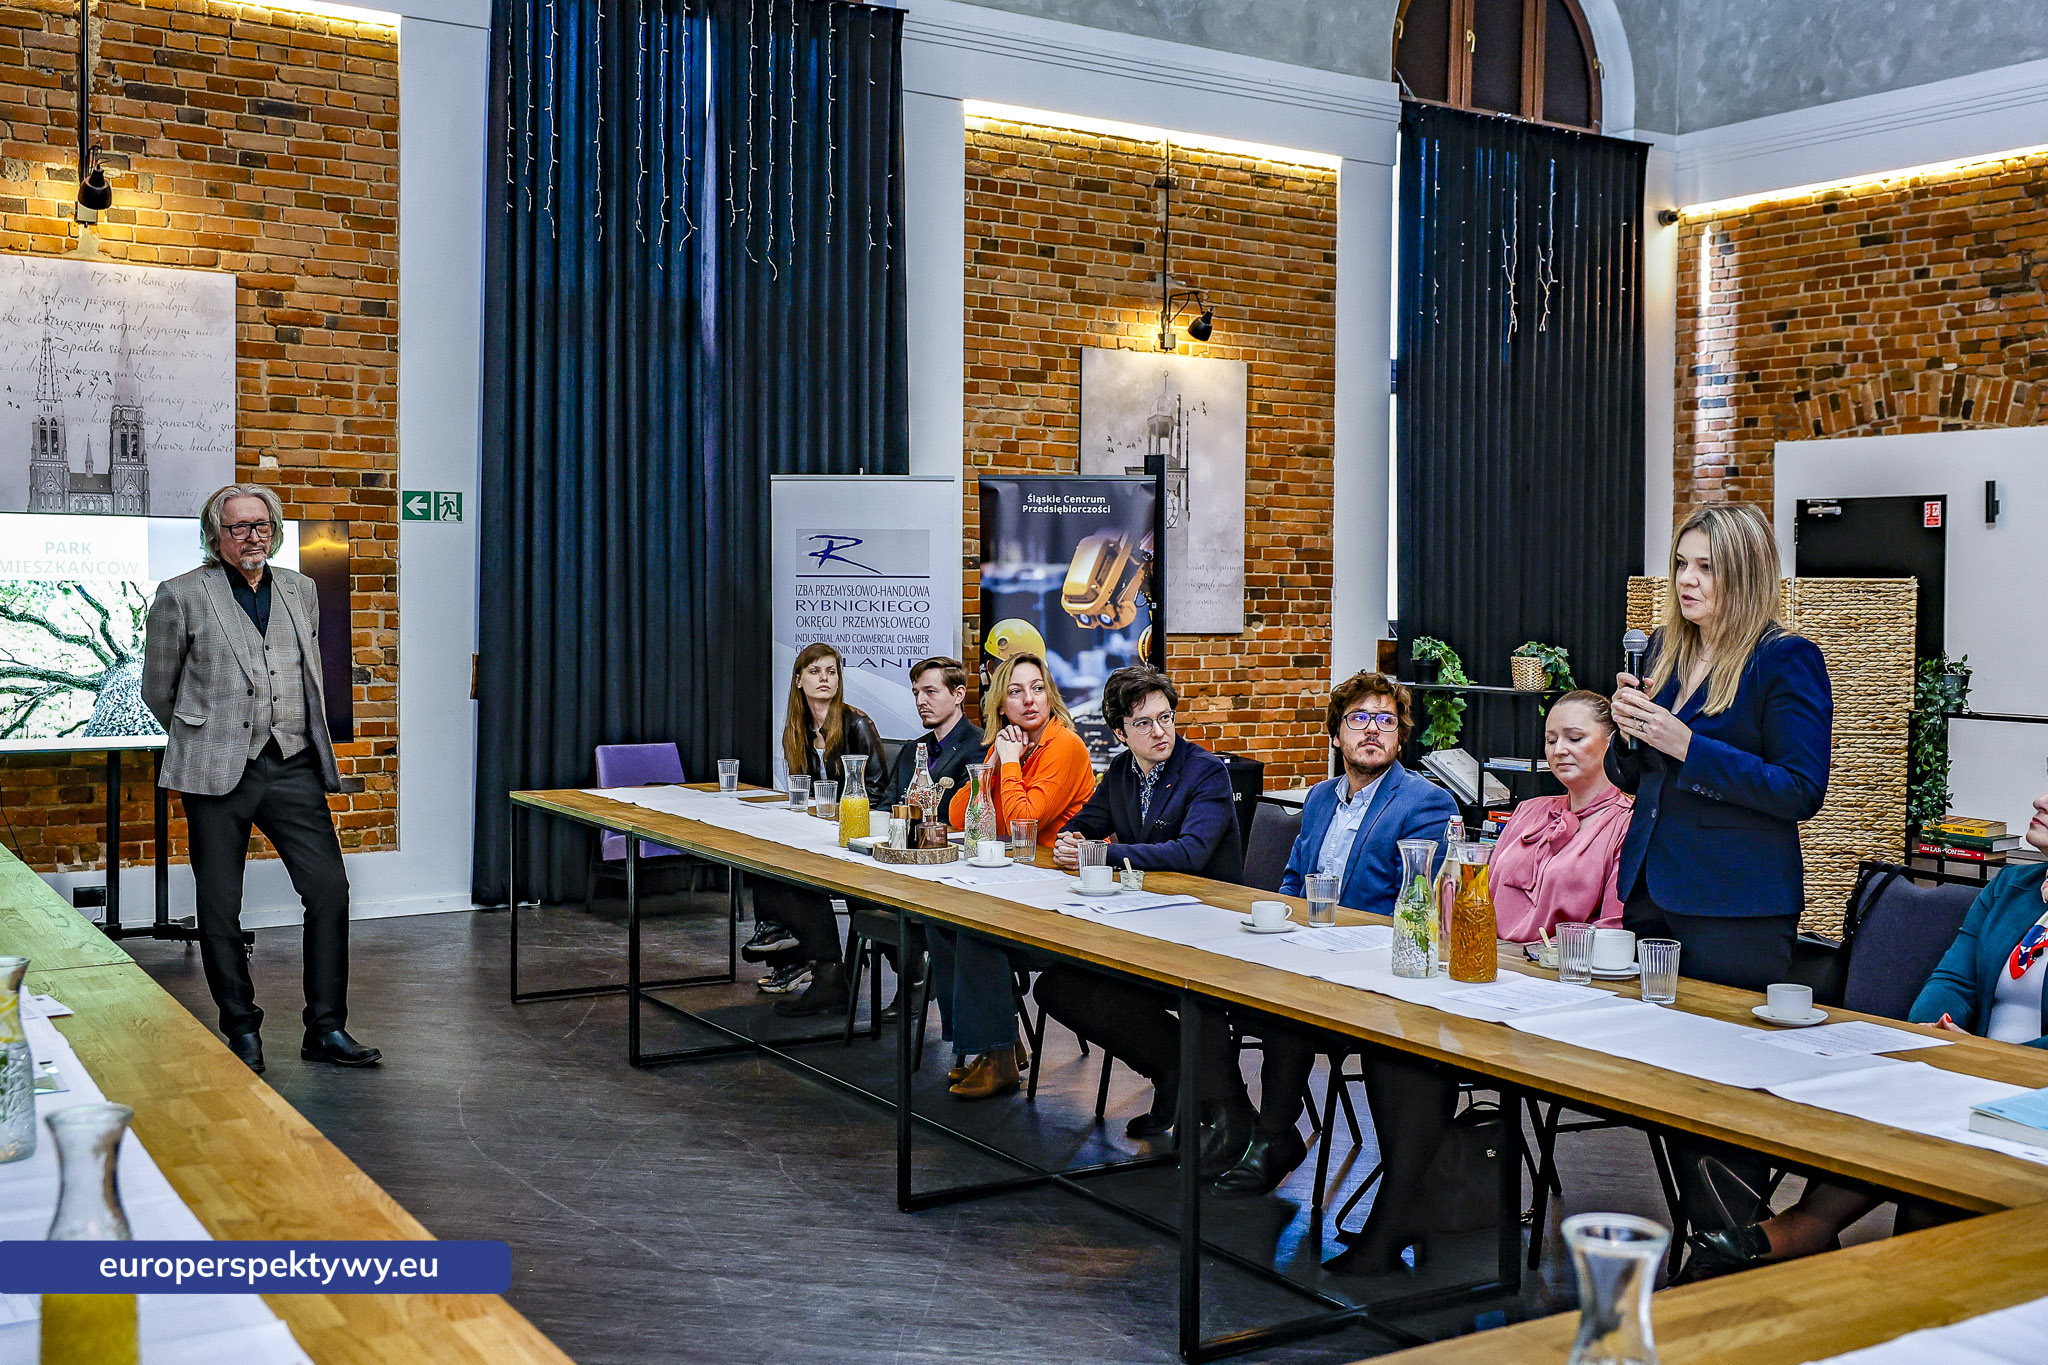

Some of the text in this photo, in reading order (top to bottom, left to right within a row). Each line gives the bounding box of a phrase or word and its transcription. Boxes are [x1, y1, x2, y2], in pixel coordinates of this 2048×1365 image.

[1027, 493, 1106, 505] Śląskie Centrum
[1022, 504, 1111, 515] Przedsiębiorczości
[45, 541, 92, 555] PARK
[795, 585, 930, 597] IZBA PRZEMYSŁOWO-HANDLOWA
[795, 600, 930, 612] RYBNICKIEGO
[796, 615, 930, 630] OKRĘGU PRZEMYSŁOWEGO
[795, 633, 929, 643] INDUSTRIAL AND COMMERCIAL CHAMBER
[852, 645, 895, 655] INDUSTRIAL
[897, 646, 929, 655] DISTRICT
